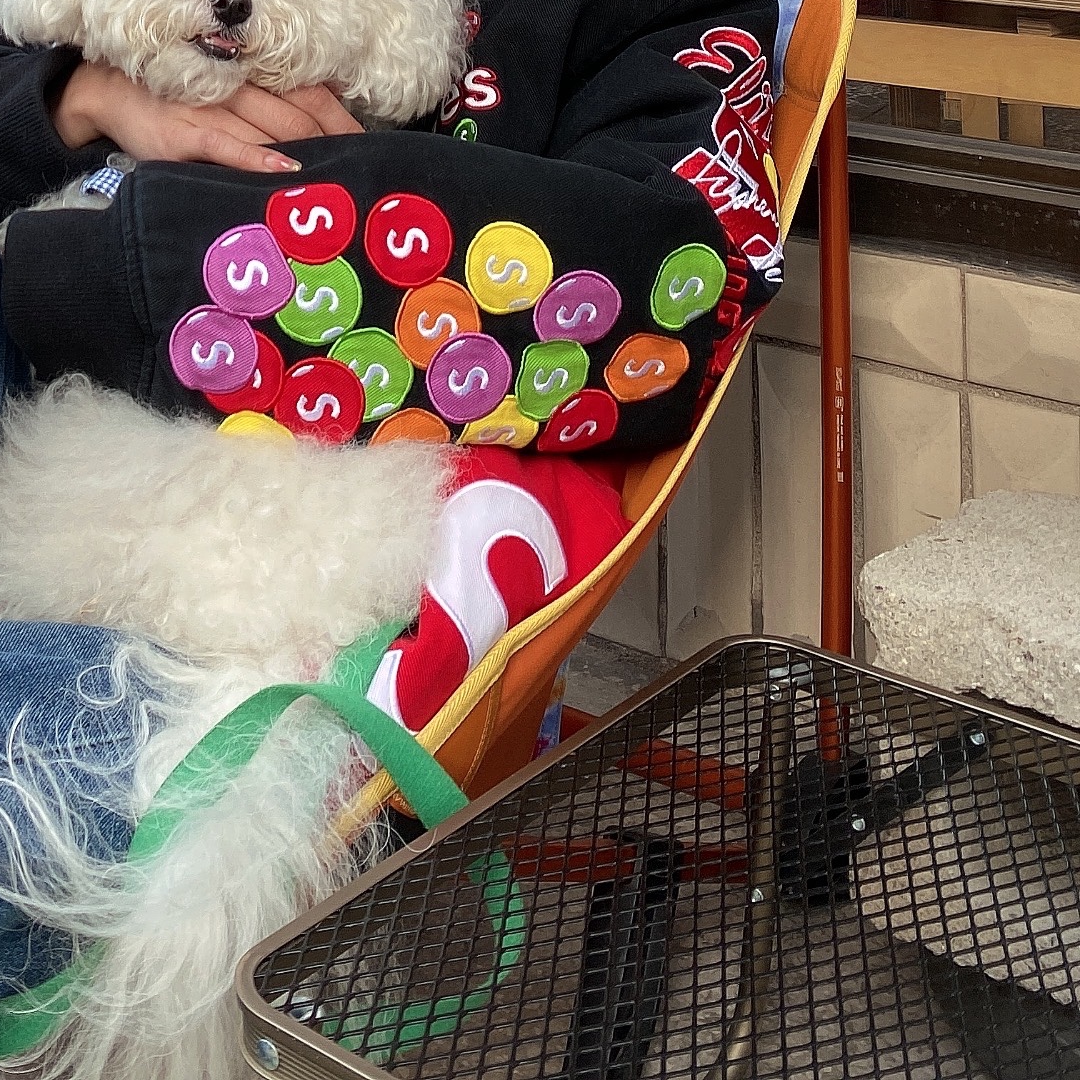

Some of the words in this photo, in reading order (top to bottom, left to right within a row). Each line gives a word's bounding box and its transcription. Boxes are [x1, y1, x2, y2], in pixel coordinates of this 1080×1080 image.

[289, 205, 333, 236] S
[386, 226, 429, 259] S
[226, 259, 269, 292] S
[484, 253, 528, 286] S
[294, 282, 339, 313] S
[191, 340, 235, 370] S
[448, 366, 489, 397] S
[296, 392, 341, 422] S
